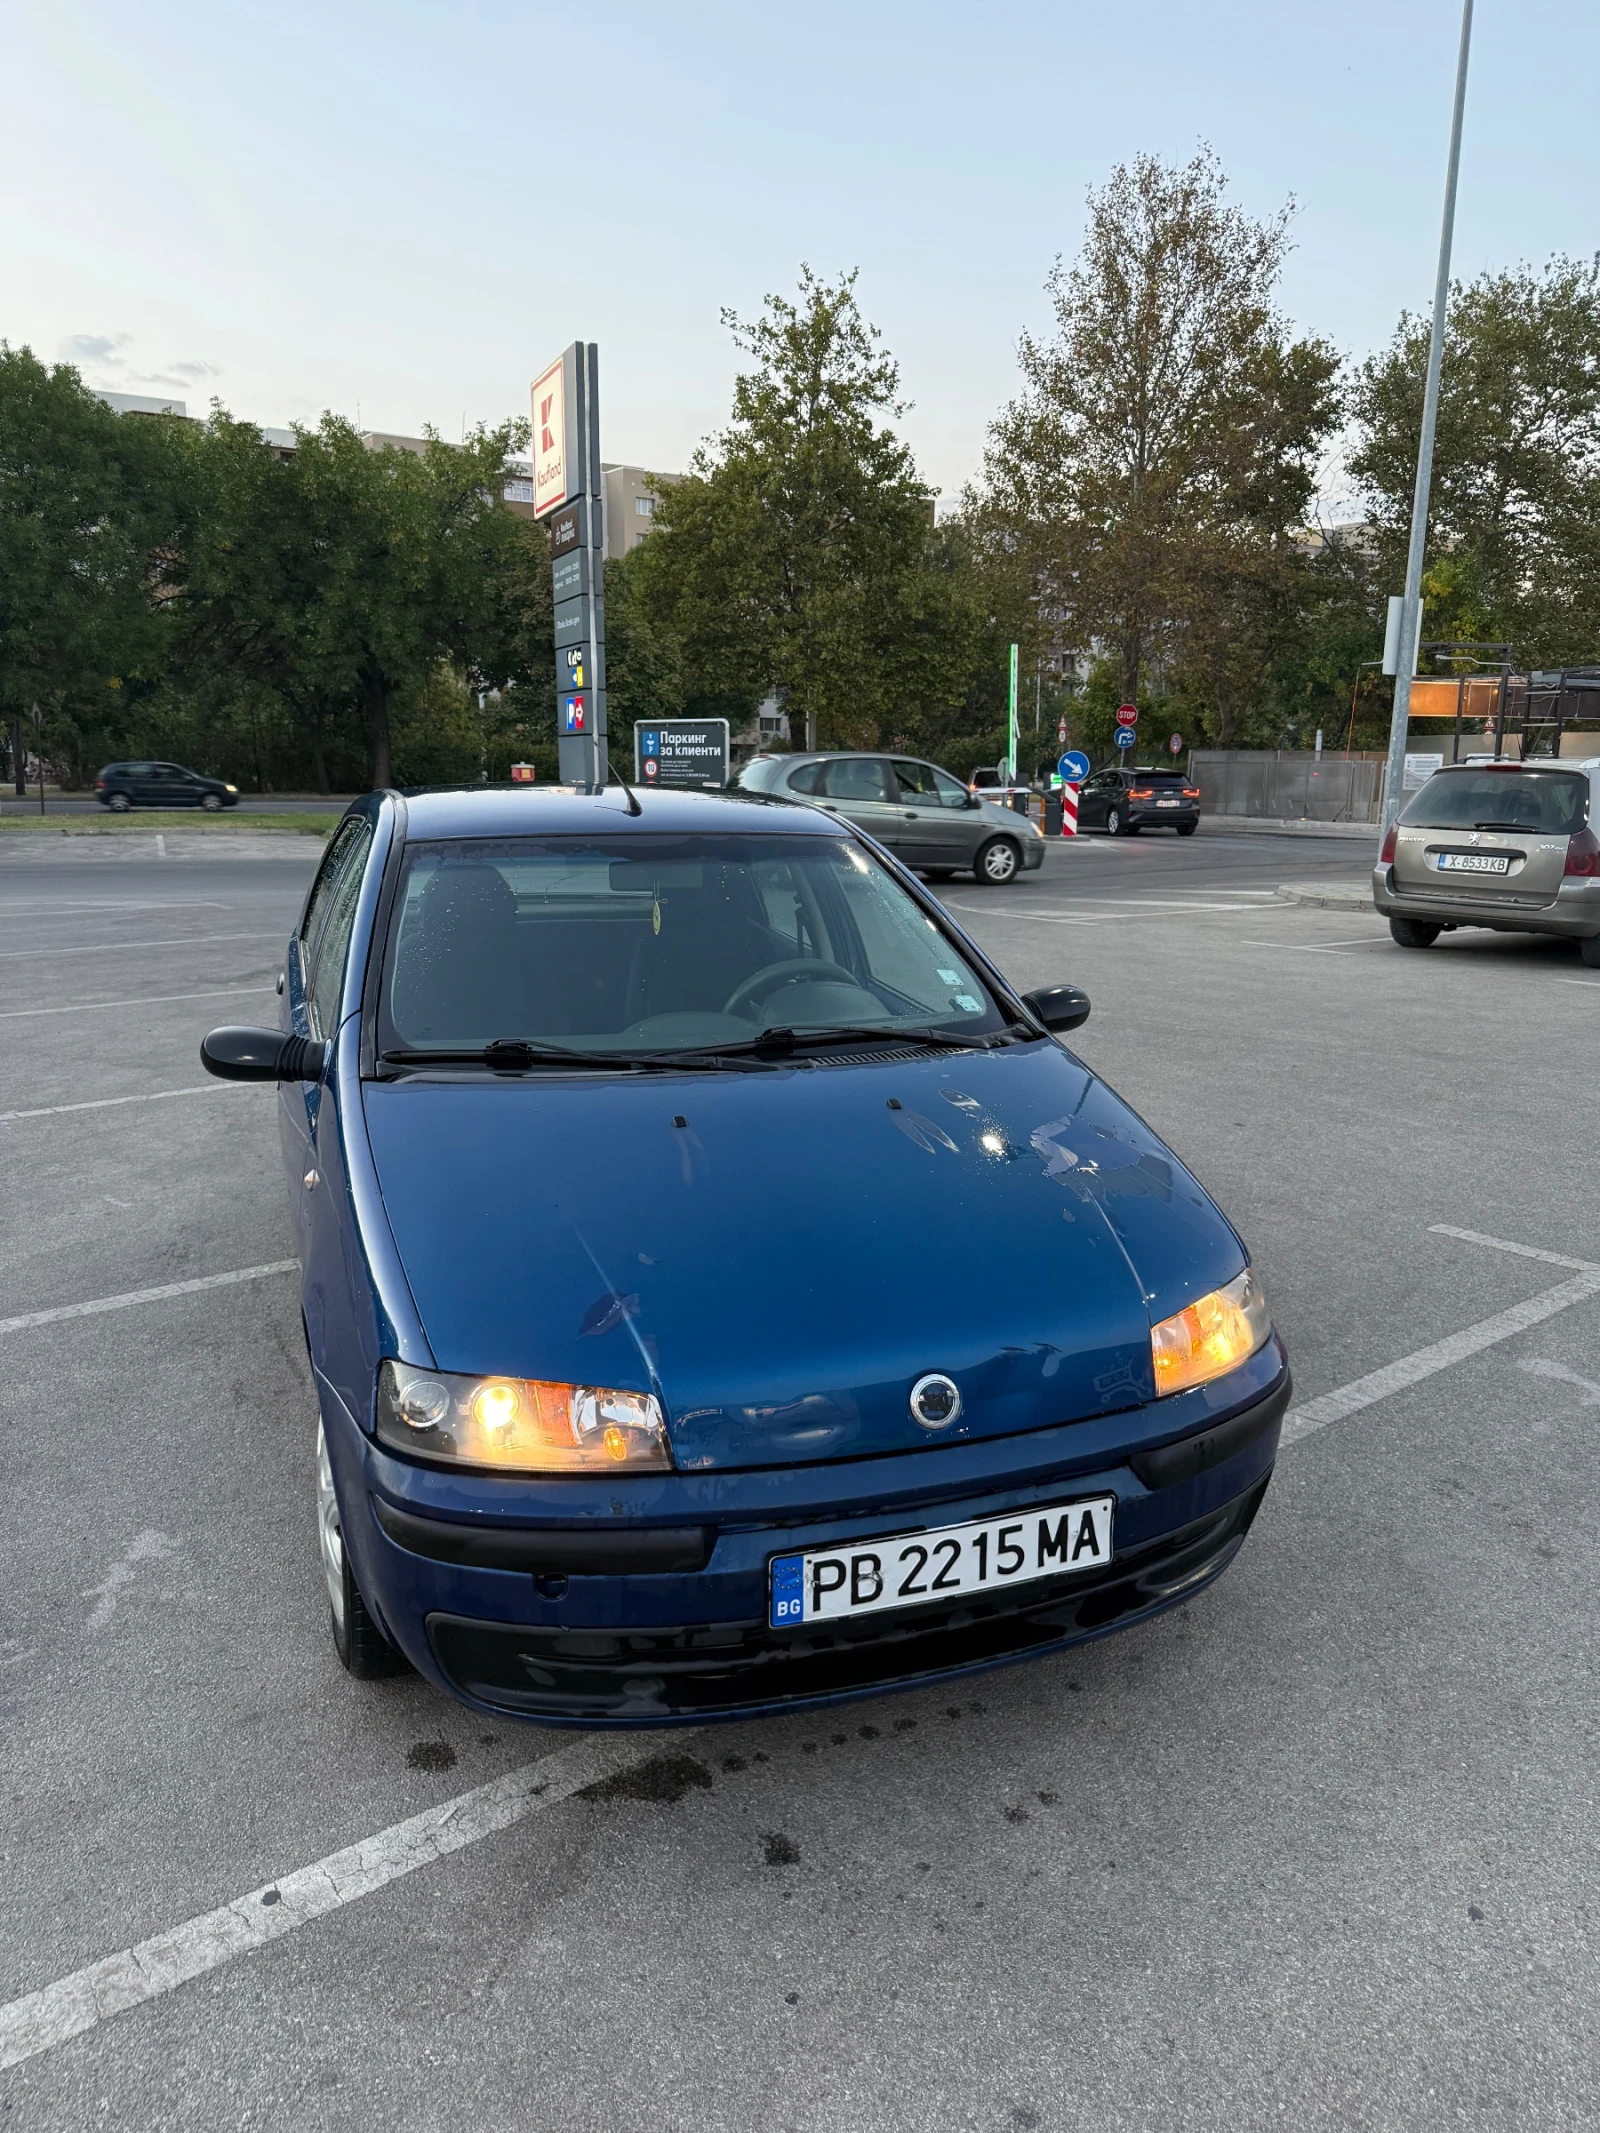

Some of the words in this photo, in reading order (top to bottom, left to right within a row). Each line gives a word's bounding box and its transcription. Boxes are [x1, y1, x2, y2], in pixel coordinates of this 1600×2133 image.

[1119, 711, 1135, 719] STOP
[660, 731, 707, 747] Паркинг
[660, 747, 673, 756] за
[675, 747, 721, 756] клиенти
[648, 764, 654, 772] 10
[898, 1523, 1025, 1597] 2215
[1037, 1509, 1101, 1568] MA
[777, 1599, 801, 1617] BG
